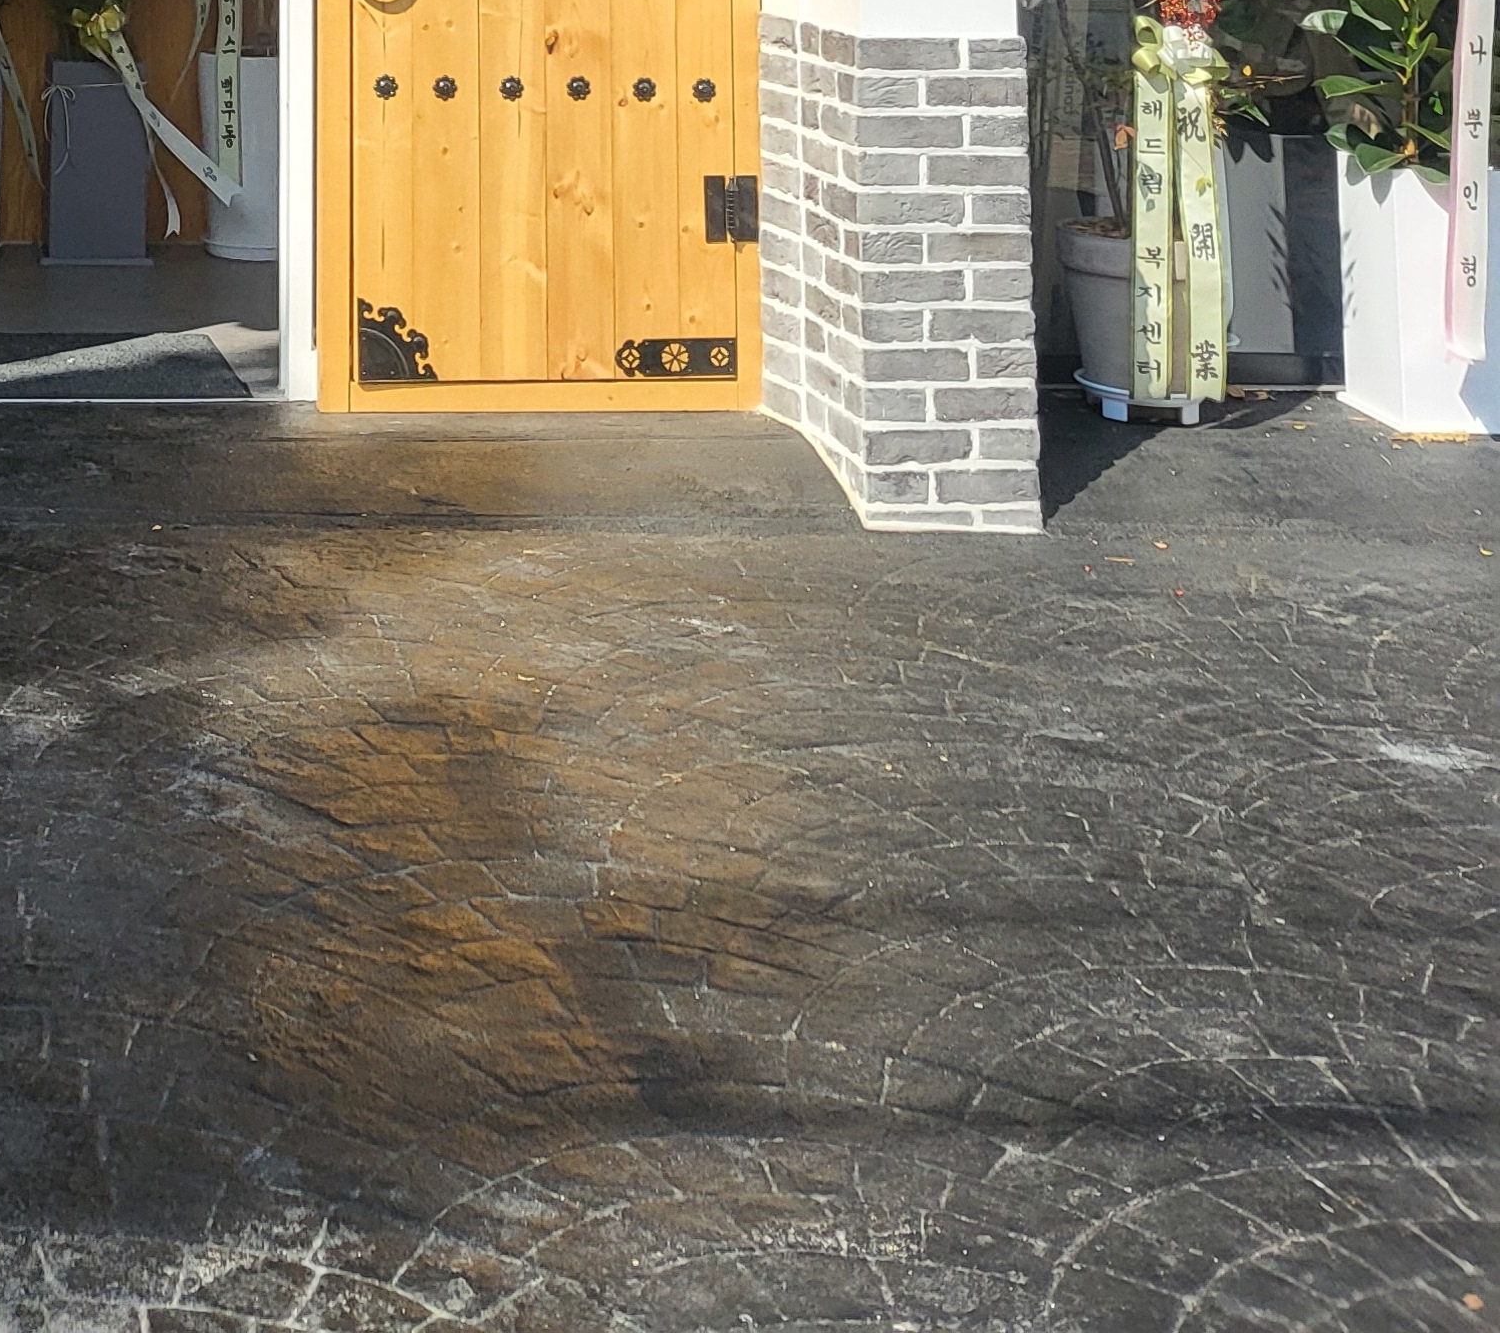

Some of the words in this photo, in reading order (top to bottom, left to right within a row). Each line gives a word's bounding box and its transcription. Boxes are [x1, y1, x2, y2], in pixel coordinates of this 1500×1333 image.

[220, 76, 237, 149] 백무동
[1138, 99, 1166, 195] 해드림
[1136, 245, 1166, 382] 복지센터
